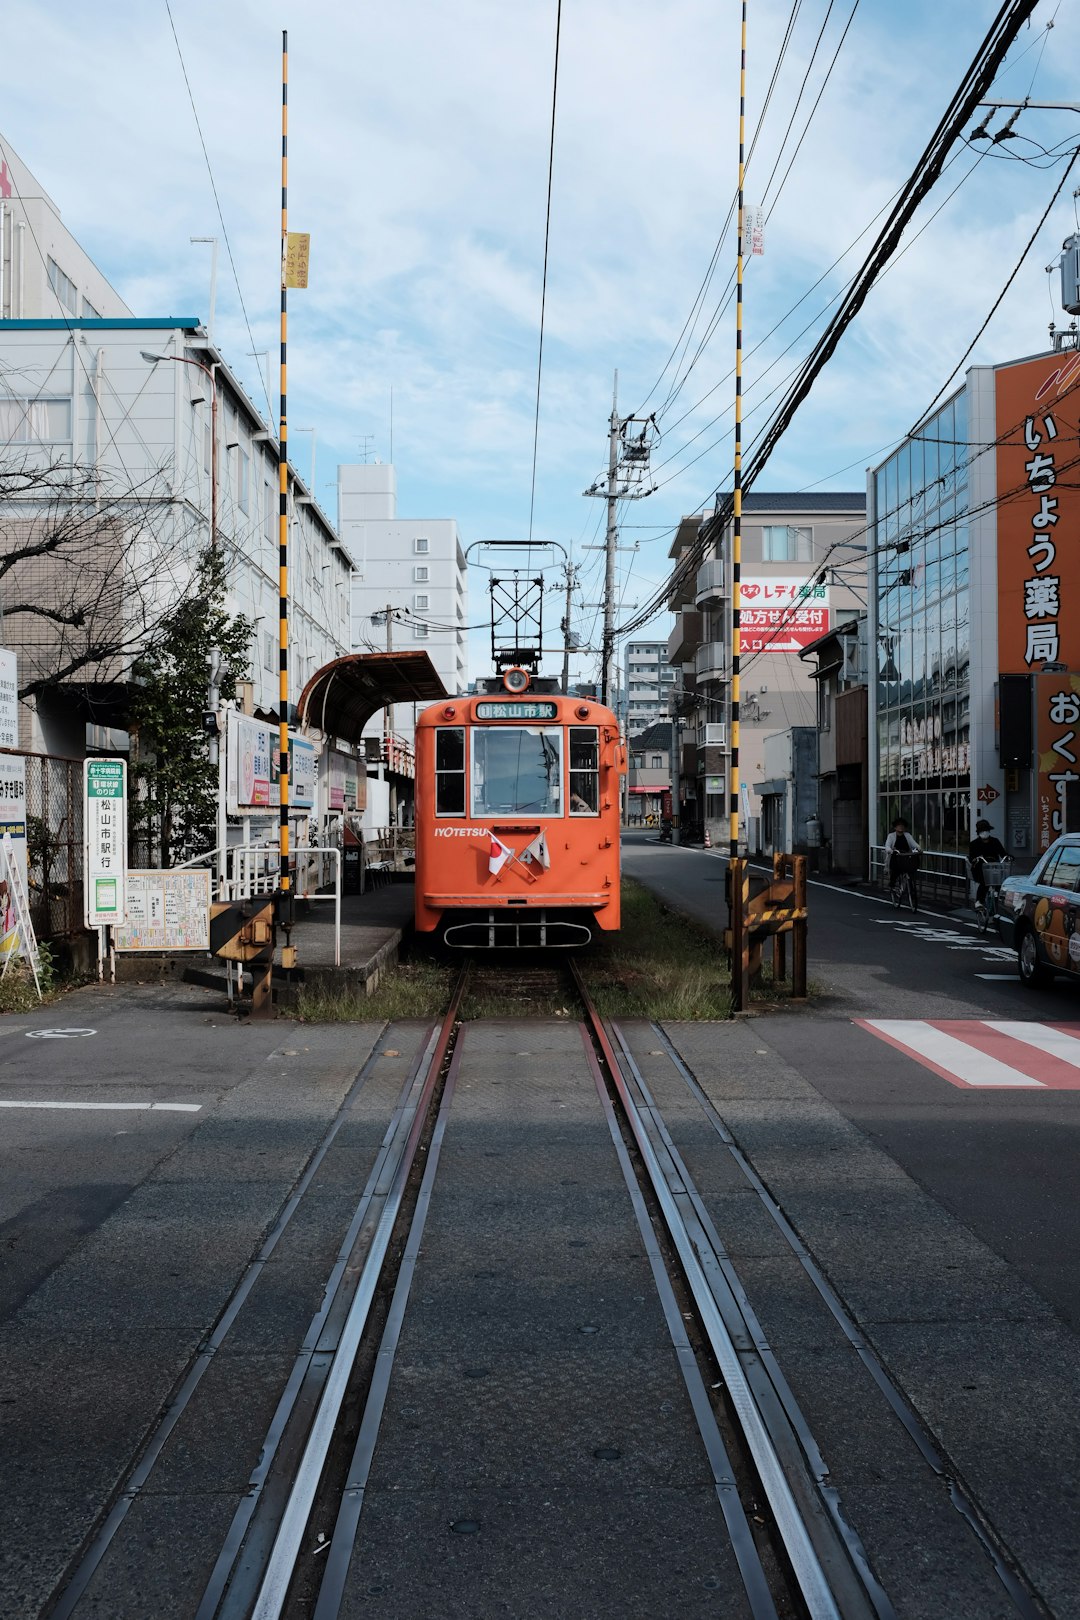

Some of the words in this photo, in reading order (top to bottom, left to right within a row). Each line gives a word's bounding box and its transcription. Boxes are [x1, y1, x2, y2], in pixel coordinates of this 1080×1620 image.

[286, 245, 296, 276] しばらく
[297, 235, 307, 287] お待ち下さい
[1024, 415, 1061, 667] いちょう薬局
[764, 585, 826, 598] レディ薬局
[740, 610, 823, 625] 処方せん受付
[741, 639, 762, 650] 入口
[493, 704, 552, 718] 松山市駅
[979, 790, 997, 800] 入口
[1040, 795, 1050, 849] いちょう薬局
[101, 799, 111, 868] 松山市駅行
[434, 827, 488, 838] IYOTETSU
